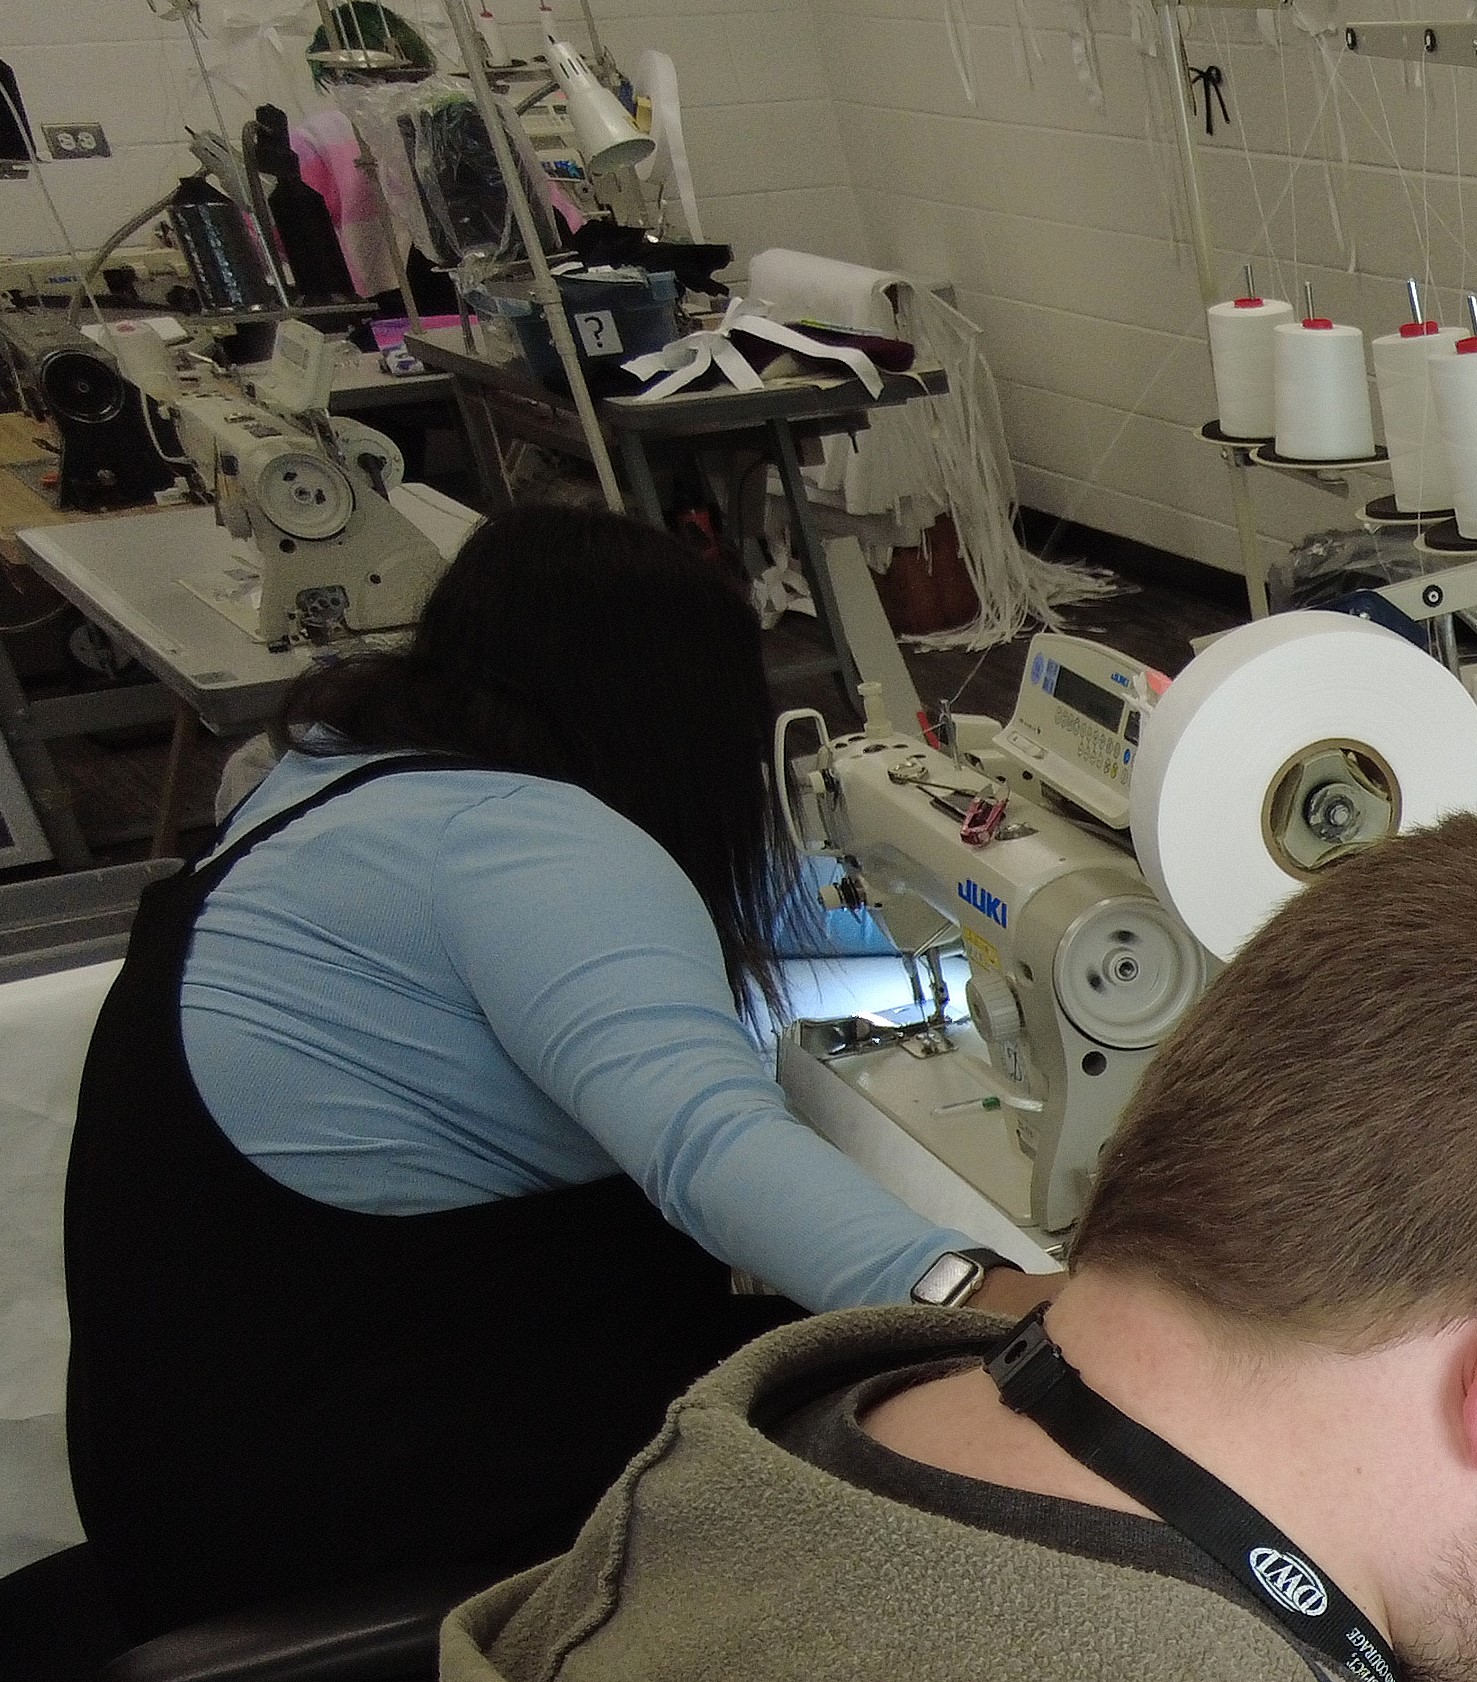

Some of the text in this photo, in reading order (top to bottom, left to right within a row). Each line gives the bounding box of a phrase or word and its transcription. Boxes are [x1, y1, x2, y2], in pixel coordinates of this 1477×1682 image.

[584, 316, 604, 348] ?
[958, 879, 1008, 930] JUKI
[1346, 1627, 1390, 1678] COURAGE
